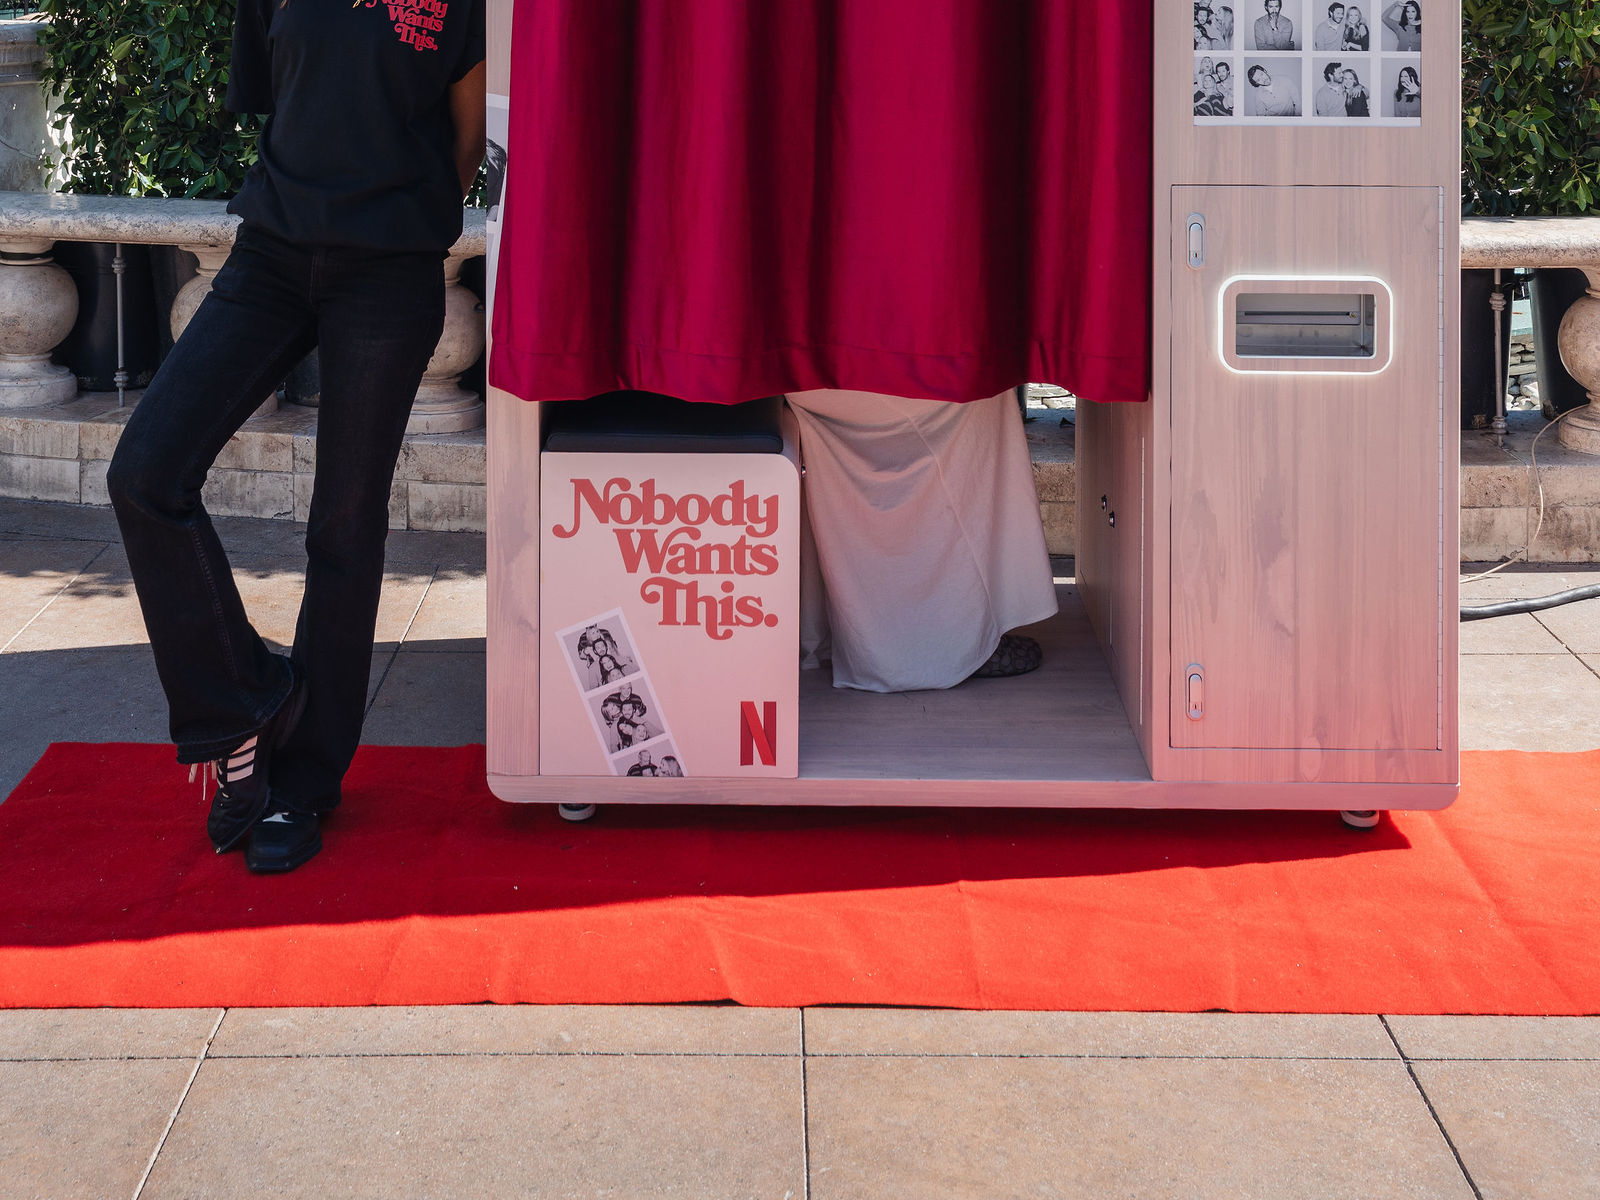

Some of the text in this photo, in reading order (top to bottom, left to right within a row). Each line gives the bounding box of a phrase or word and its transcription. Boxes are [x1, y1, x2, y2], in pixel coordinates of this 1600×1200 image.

[387, 5, 444, 32] Wants
[394, 22, 438, 51] This.
[552, 477, 779, 538] Nobody
[612, 526, 779, 575] Wants
[640, 577, 779, 640] This.
[740, 701, 777, 766] N
